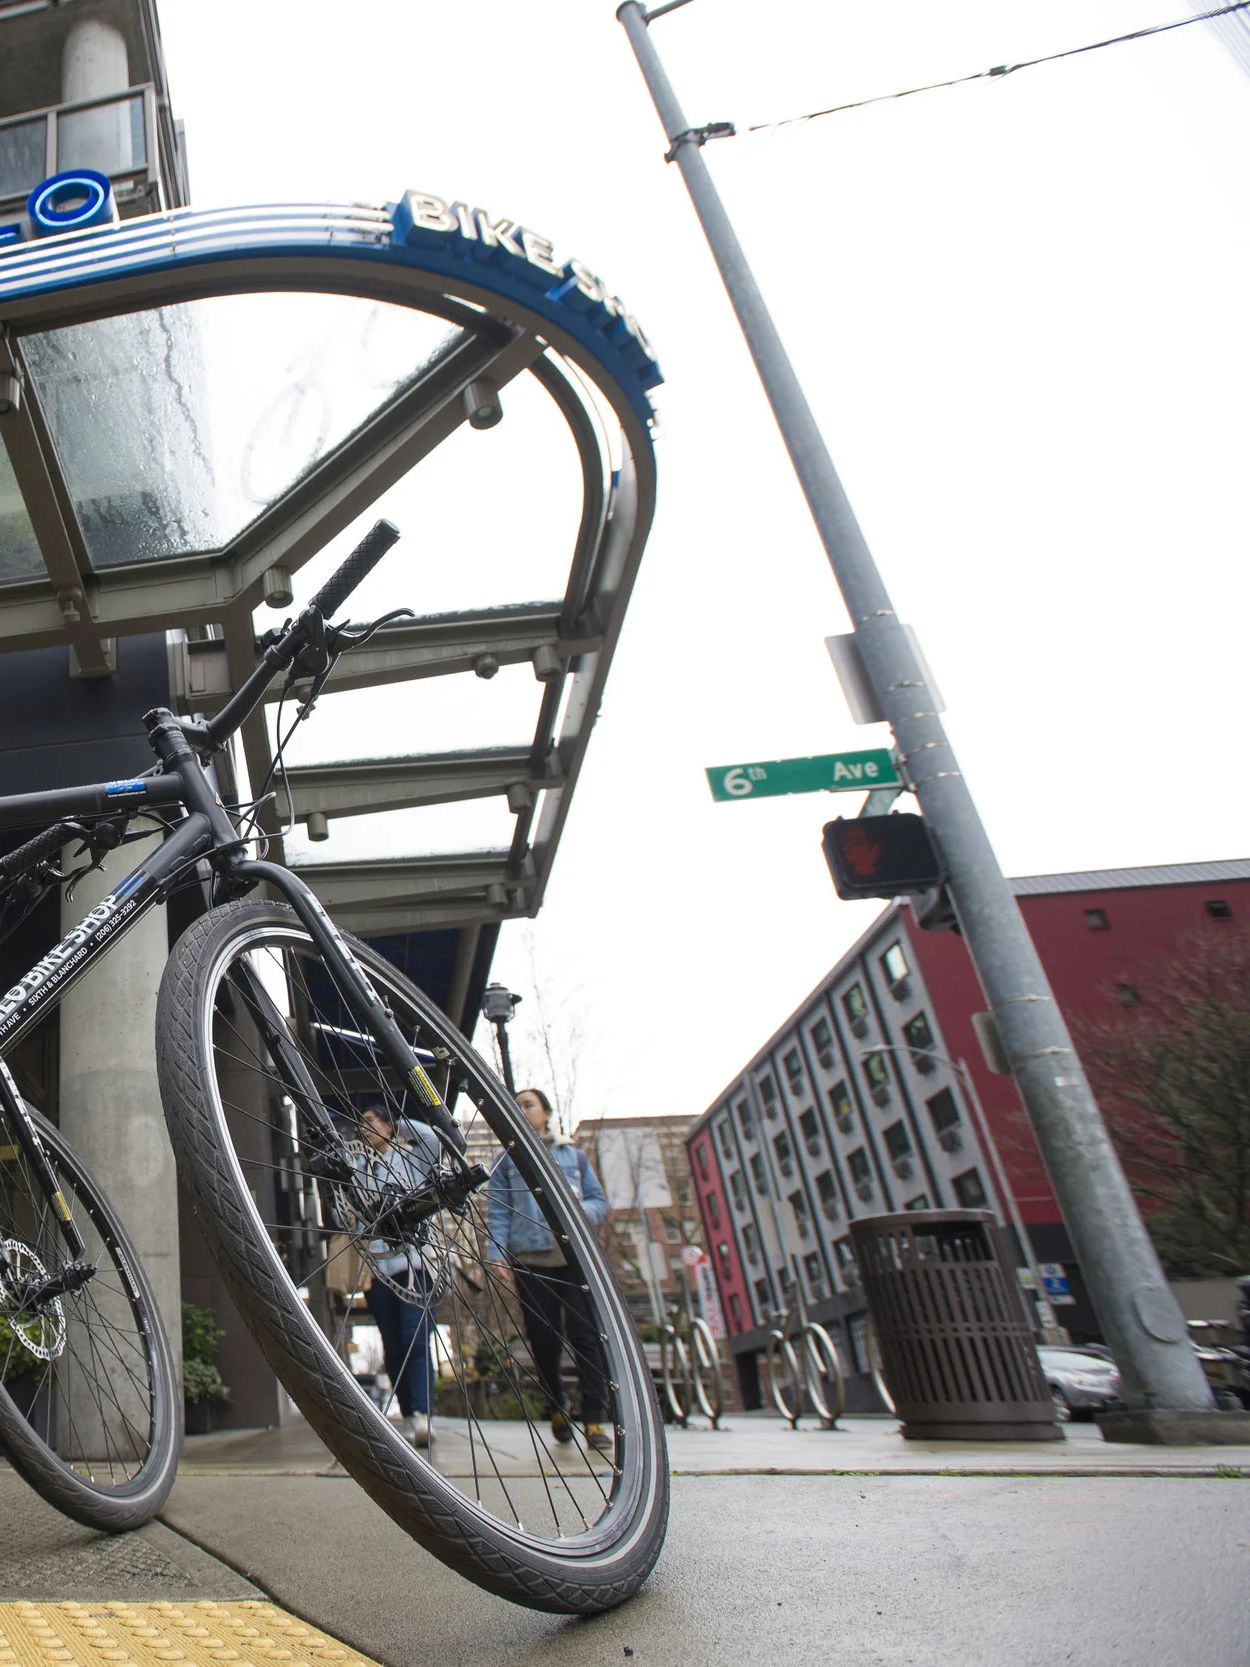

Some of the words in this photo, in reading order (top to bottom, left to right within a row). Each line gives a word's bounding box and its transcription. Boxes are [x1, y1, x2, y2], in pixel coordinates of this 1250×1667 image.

[400, 189, 565, 278] BIKE
[723, 767, 768, 796] 6th
[833, 761, 880, 781] Ave
[6, 1012, 21, 1030] AVE
[28, 986, 48, 1006] SIXTH
[47, 979, 54, 989] &
[51, 947, 88, 984] BLANCHARD
[95, 923, 112, 942] (206)
[110, 900, 137, 926] 325-3292
[21, 943, 72, 988] BIKE
[66, 894, 121, 944] SHOP
